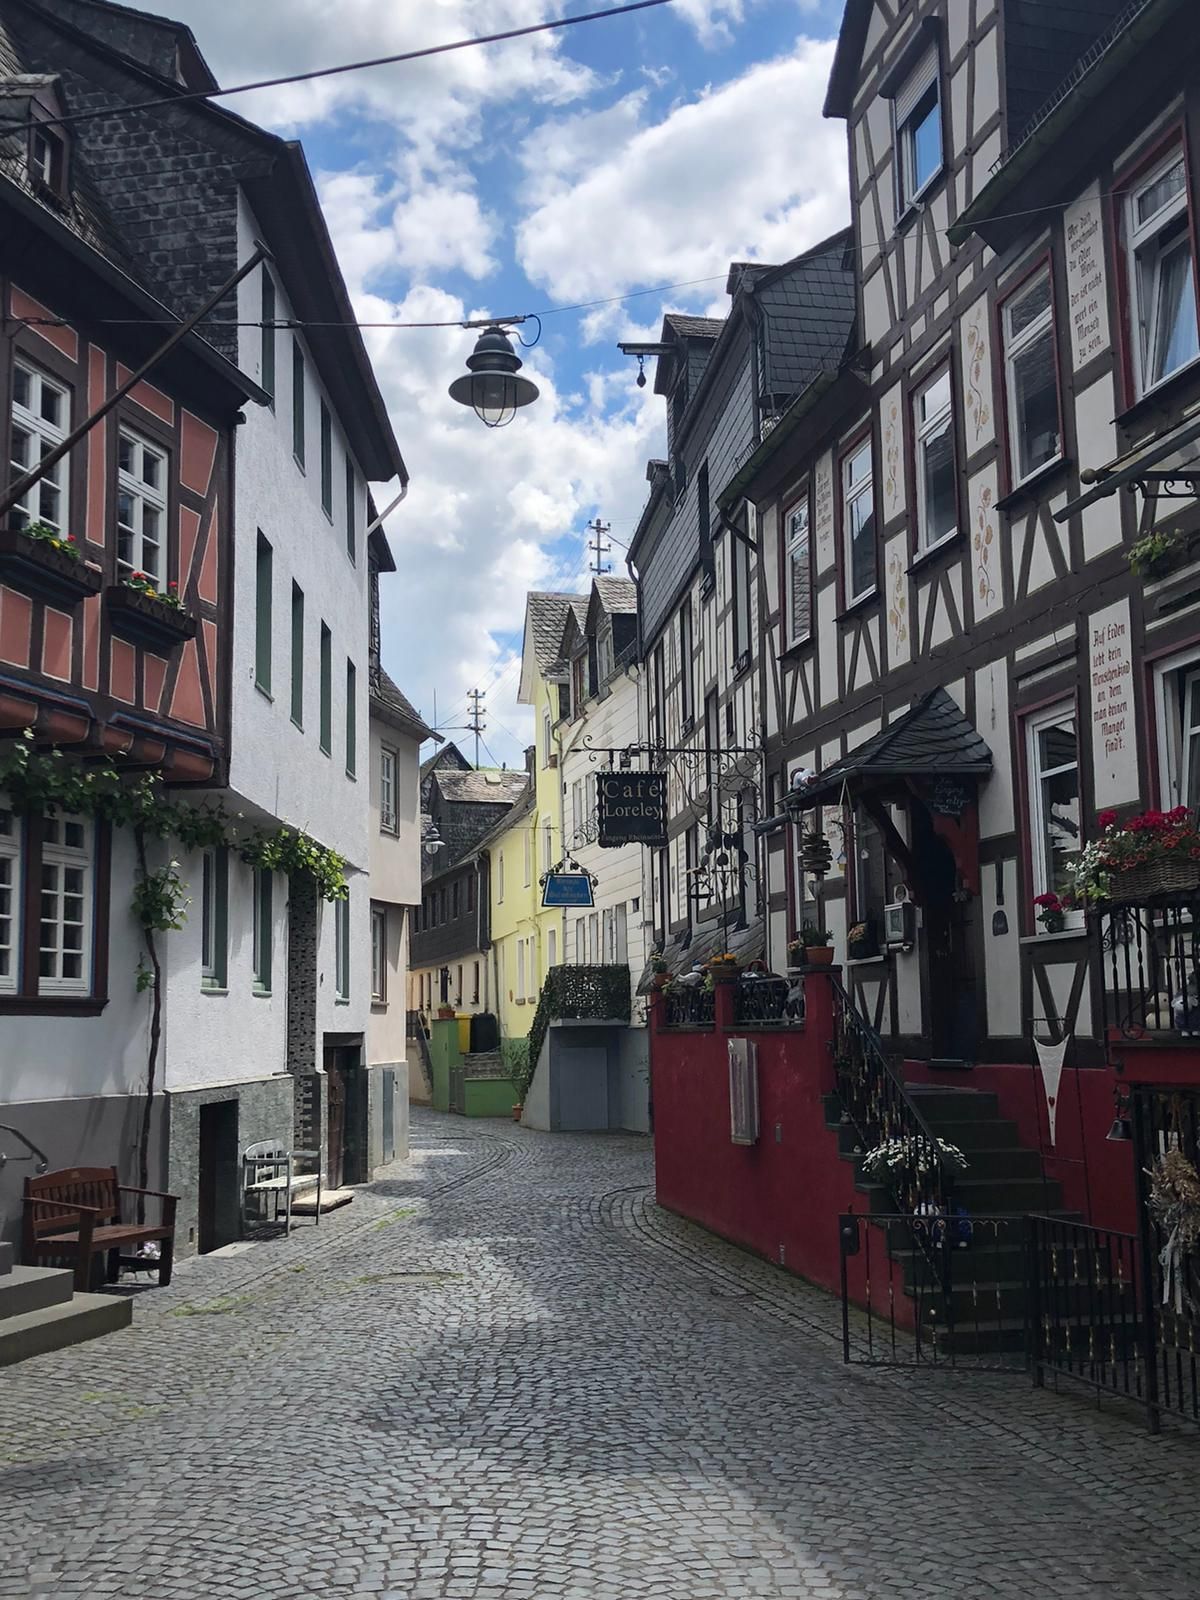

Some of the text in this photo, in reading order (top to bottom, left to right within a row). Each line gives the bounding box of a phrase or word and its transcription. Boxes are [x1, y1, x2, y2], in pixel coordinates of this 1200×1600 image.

[1070, 271, 1102, 307] der ist nicht
[1088, 298, 1098, 314] ein
[1077, 316, 1099, 342] Mensch
[1079, 347, 1087, 364] zu
[1093, 623, 1125, 647] Auf Erden
[1093, 645, 1122, 668] lebt kein
[1097, 685, 1122, 703] an dem
[1093, 701, 1127, 722] man keinen
[1101, 717, 1125, 736] Mangel
[604, 779, 660, 799] Café
[604, 801, 663, 820] Loreley
